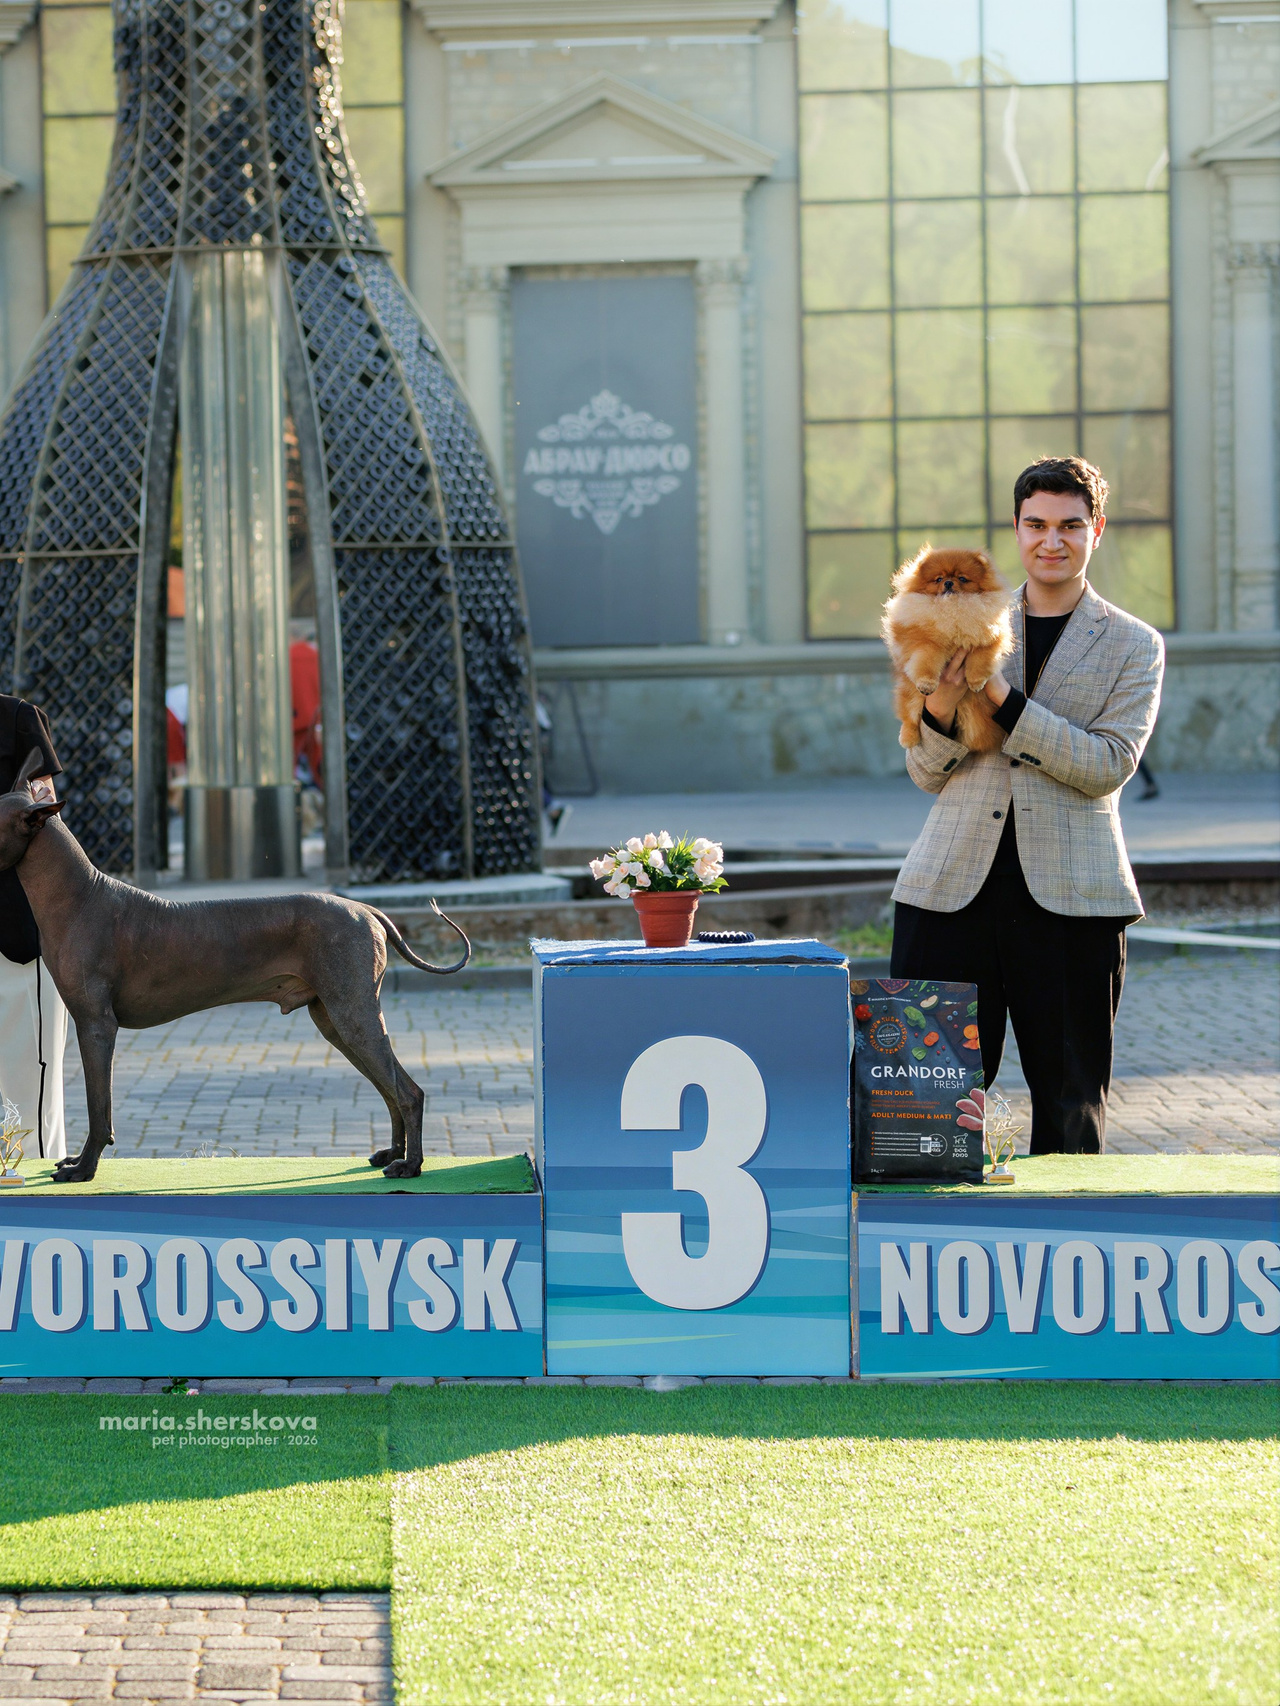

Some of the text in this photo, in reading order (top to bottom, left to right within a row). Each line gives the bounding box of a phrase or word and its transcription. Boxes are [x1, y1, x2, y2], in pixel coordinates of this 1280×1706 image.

[523, 443, 691, 476] АБРАУ-ДЮРСО
[871, 1065, 966, 1079] GRANDORF
[934, 1080, 964, 1089] FRESH
[621, 1035, 769, 1310] 3
[880, 1239, 1280, 1336] NOVOROS
